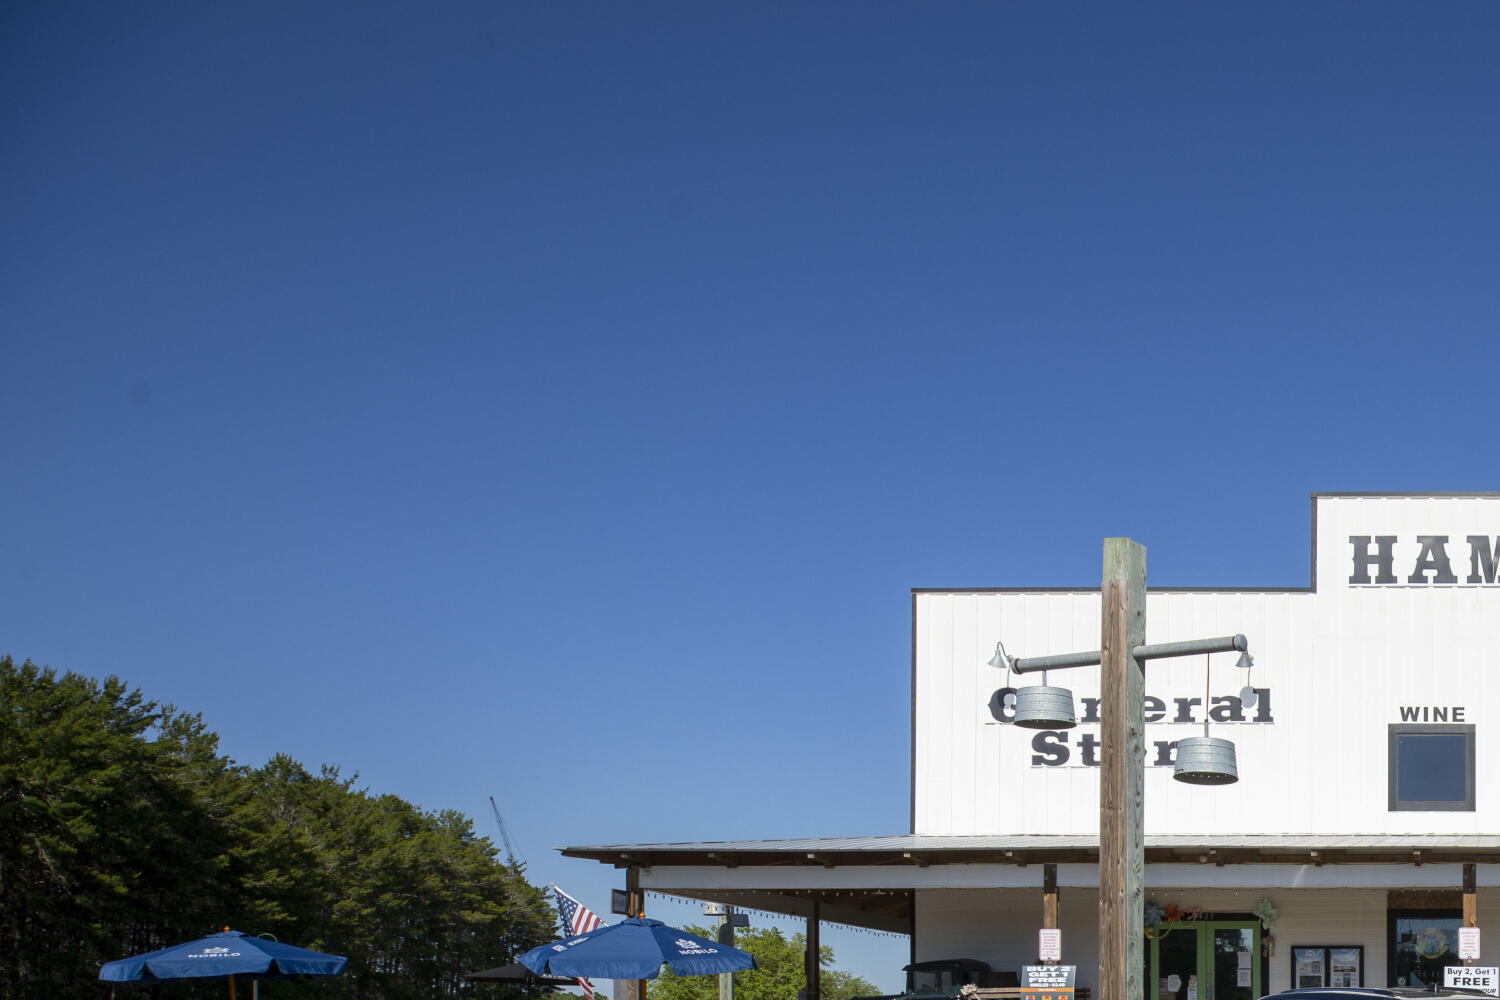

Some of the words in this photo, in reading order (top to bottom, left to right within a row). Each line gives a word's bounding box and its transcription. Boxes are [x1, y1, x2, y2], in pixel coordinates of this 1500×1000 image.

[987, 687, 1274, 723] Geral
[1399, 706, 1466, 723] WINE
[1031, 730, 1176, 767] Str
[1453, 978, 1490, 986] FREE
